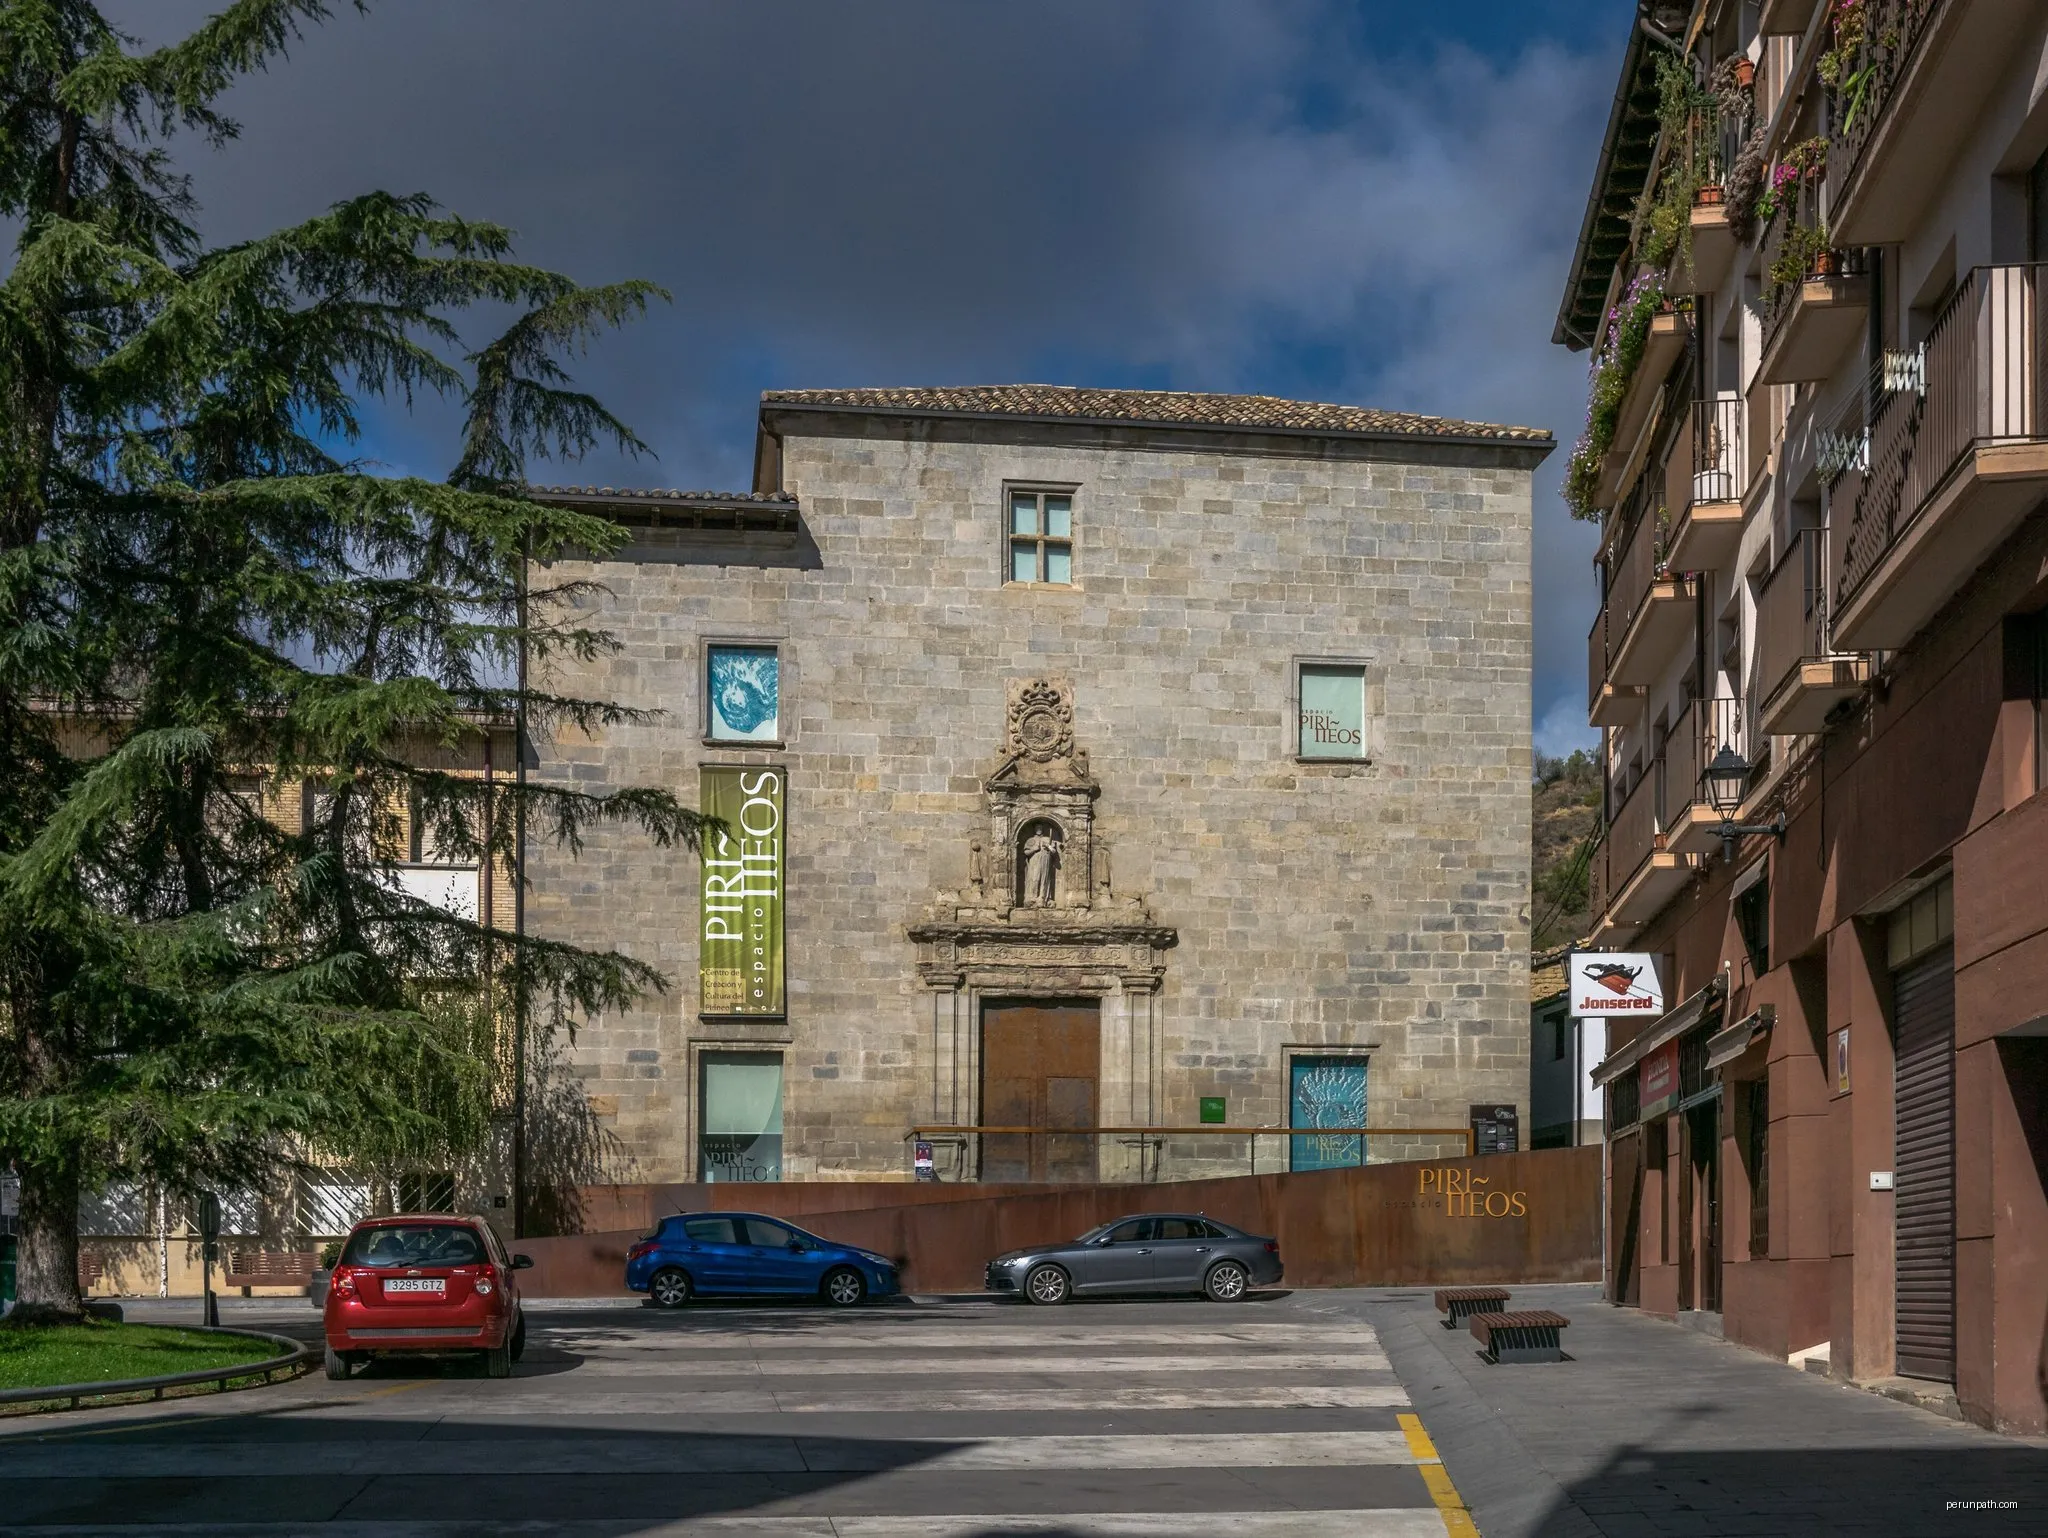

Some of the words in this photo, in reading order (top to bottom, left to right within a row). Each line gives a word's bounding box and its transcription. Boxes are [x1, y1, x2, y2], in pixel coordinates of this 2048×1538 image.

[750, 907, 767, 998] espacio
[705, 968, 730, 976] Centro
[730, 968, 740, 976] de
[705, 992, 731, 1000] Cultura
[732, 992, 744, 1000] del
[1579, 995, 1653, 1010] Jonsered
[392, 1280, 419, 1290] 3295
[421, 1280, 443, 1290] GTZ
